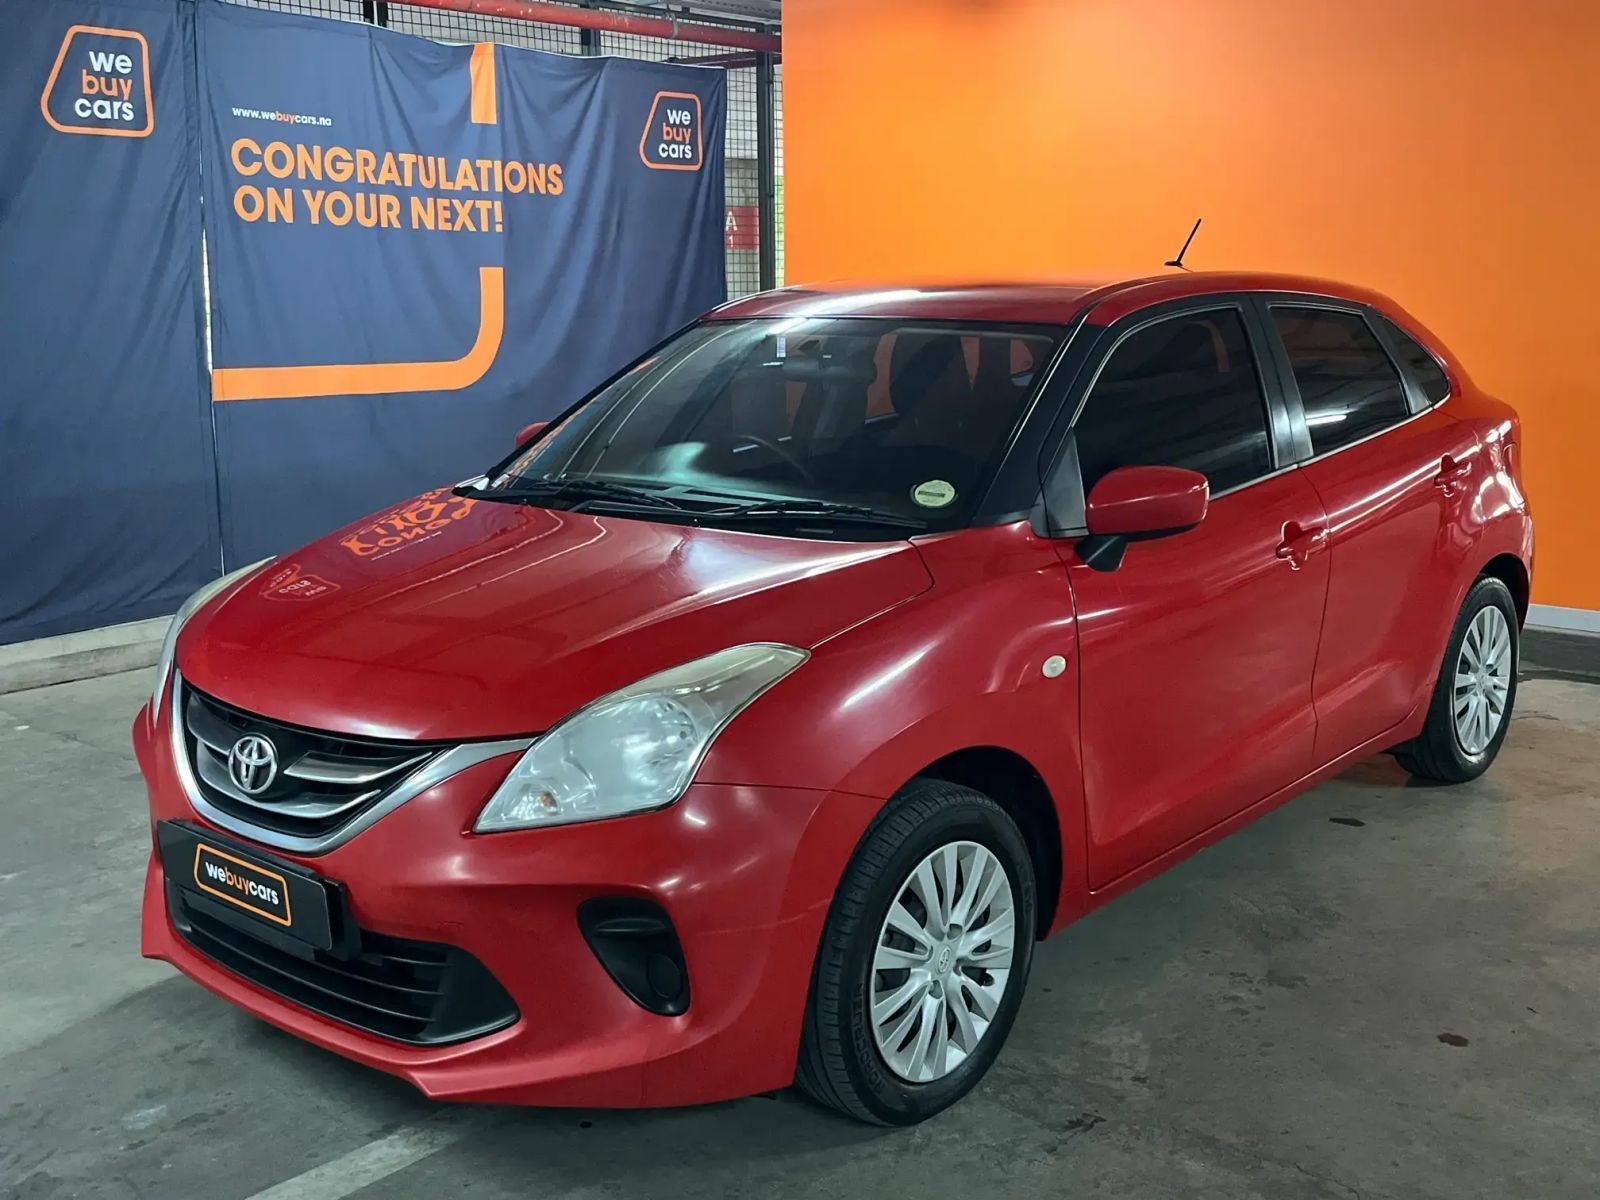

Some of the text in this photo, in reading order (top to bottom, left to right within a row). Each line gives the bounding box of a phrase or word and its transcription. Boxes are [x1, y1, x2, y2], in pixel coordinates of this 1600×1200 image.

[89, 51, 132, 74] we
[82, 69, 132, 99] buy
[75, 98, 134, 121] cars
[232, 107, 332, 126] www.webuycars.na
[667, 109, 691, 124] we
[662, 122, 691, 144] buy
[658, 143, 692, 159] cars
[231, 138, 563, 195] CONGRATULATIONS
[233, 185, 504, 232] ON YOUR NEXT!
[205, 861, 279, 904] webuycars
